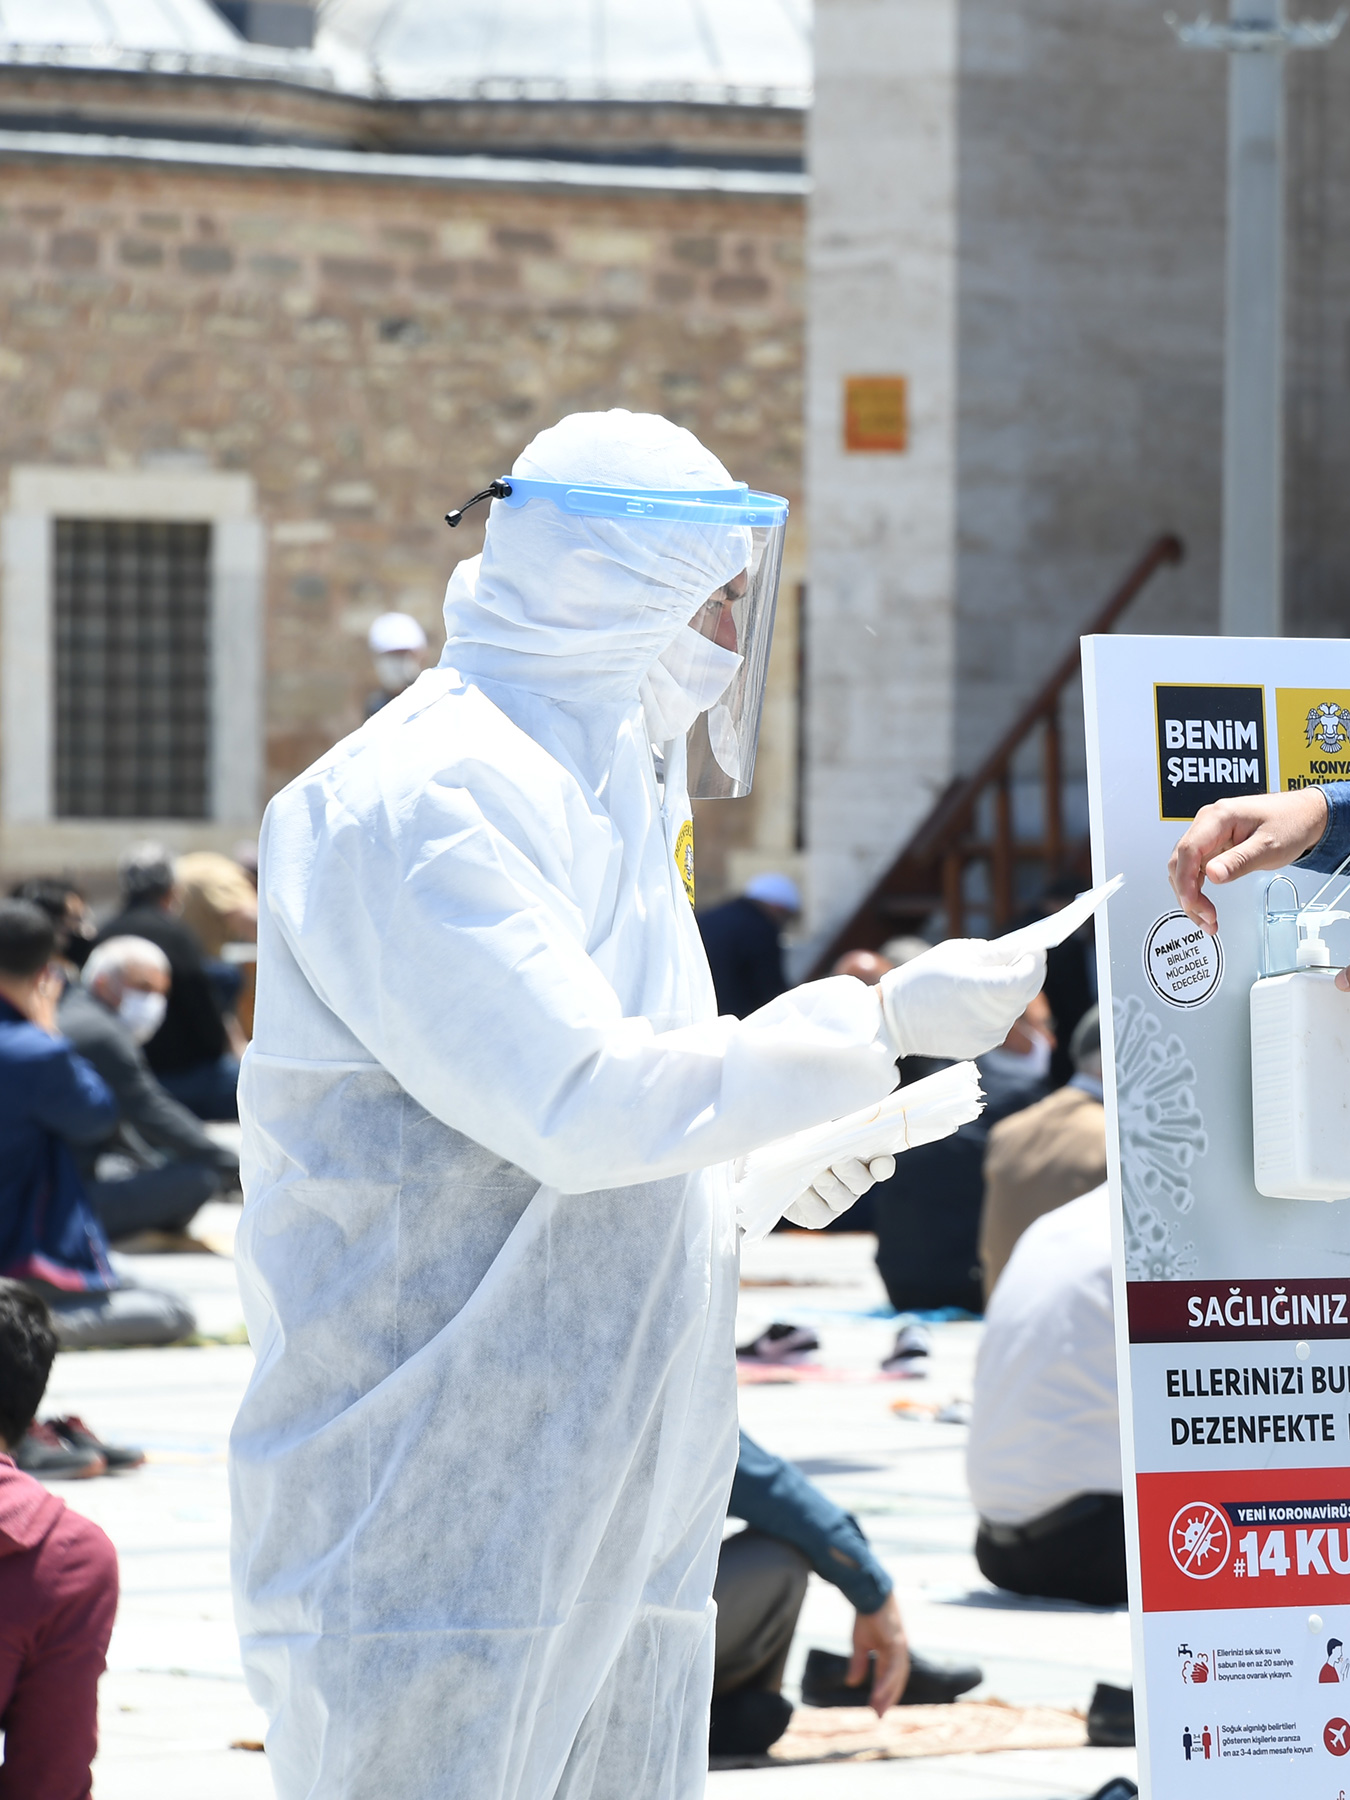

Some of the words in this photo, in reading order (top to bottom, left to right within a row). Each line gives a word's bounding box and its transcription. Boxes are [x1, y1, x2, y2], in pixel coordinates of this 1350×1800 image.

[1154, 939, 1181, 957] PANİK
[1181, 929, 1204, 945] YOK!
[1167, 946, 1200, 966] BİRLİKTE
[1166, 956, 1209, 980] MÜCADELE
[1171, 969, 1210, 991] EDECEĞİZ
[1187, 1286, 1348, 1328] SAĞLIĞINIZ
[1171, 1413, 1335, 1445] DEZENFEKTE
[1237, 1506, 1267, 1522] YENİ
[1233, 1530, 1291, 1578] #14
[1217, 1649, 1244, 1657] Ellerinizi
[1218, 1661, 1237, 1669] sabun
[1263, 1659, 1272, 1667] 20
[1273, 1659, 1294, 1667] saniye
[1218, 1673, 1246, 1682] boyunca
[1247, 1671, 1268, 1679] ovarak
[1221, 1724, 1242, 1734] Soğuk
[1222, 1736, 1251, 1746] gösteren
[1240, 1748, 1251, 1756] 3-4
[1269, 1746, 1293, 1754] mesafe
[1294, 1746, 1313, 1754] koyun
